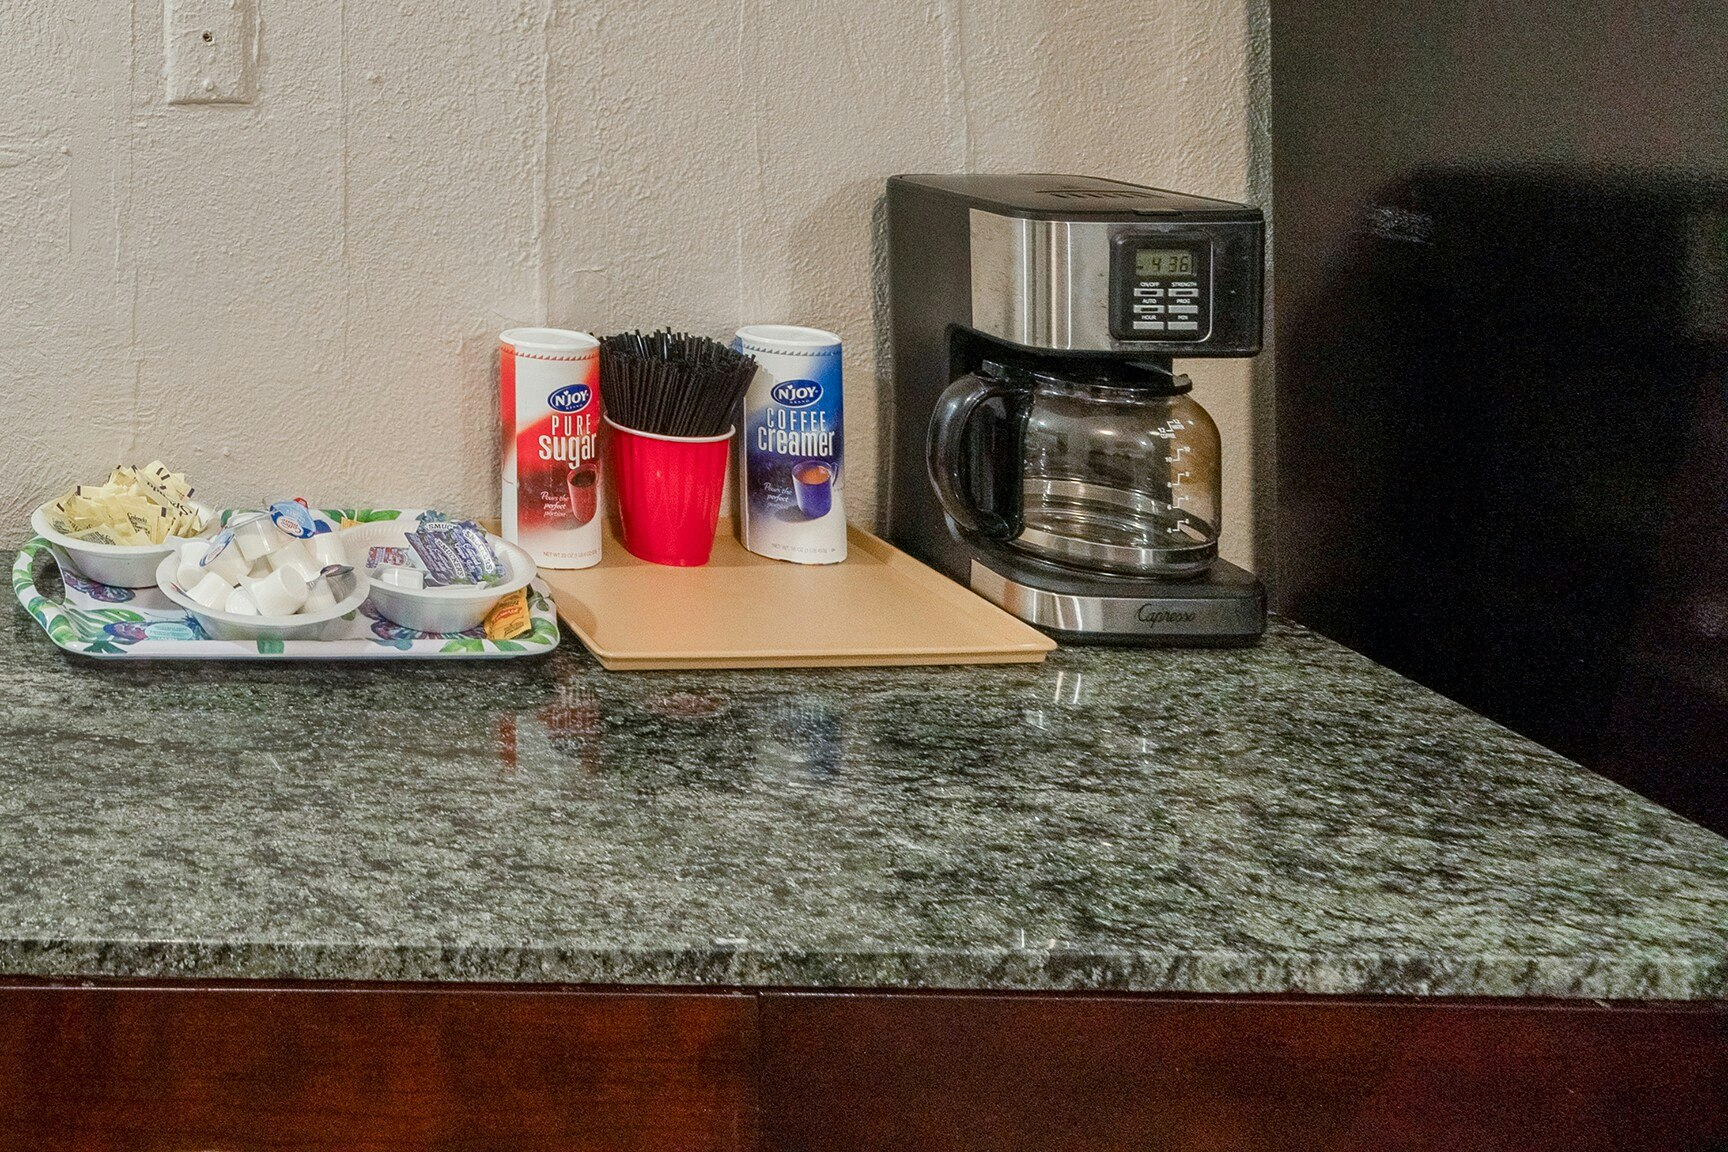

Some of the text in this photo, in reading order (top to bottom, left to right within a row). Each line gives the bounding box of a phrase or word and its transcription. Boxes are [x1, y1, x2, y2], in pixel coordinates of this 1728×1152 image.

[551, 413, 591, 437] PURE
[766, 407, 826, 432] COFFEE
[538, 432, 597, 470] sugar
[757, 426, 836, 457] creamer
